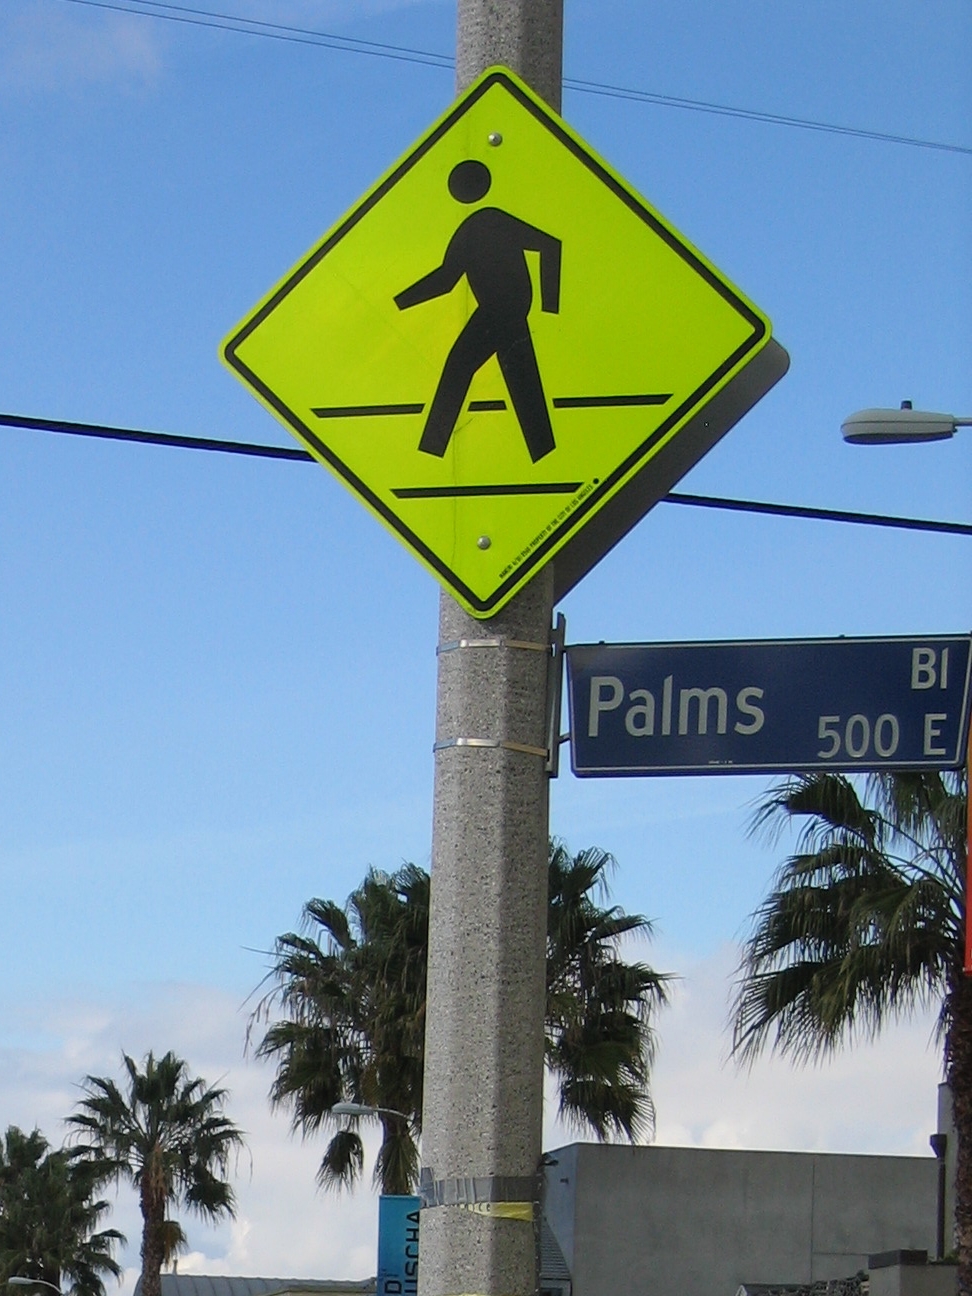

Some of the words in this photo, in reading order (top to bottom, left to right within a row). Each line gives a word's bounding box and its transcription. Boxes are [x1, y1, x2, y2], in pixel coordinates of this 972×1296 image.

[588, 674, 765, 738] Palms
[817, 712, 900, 759] 500
[923, 713, 947, 756] E
